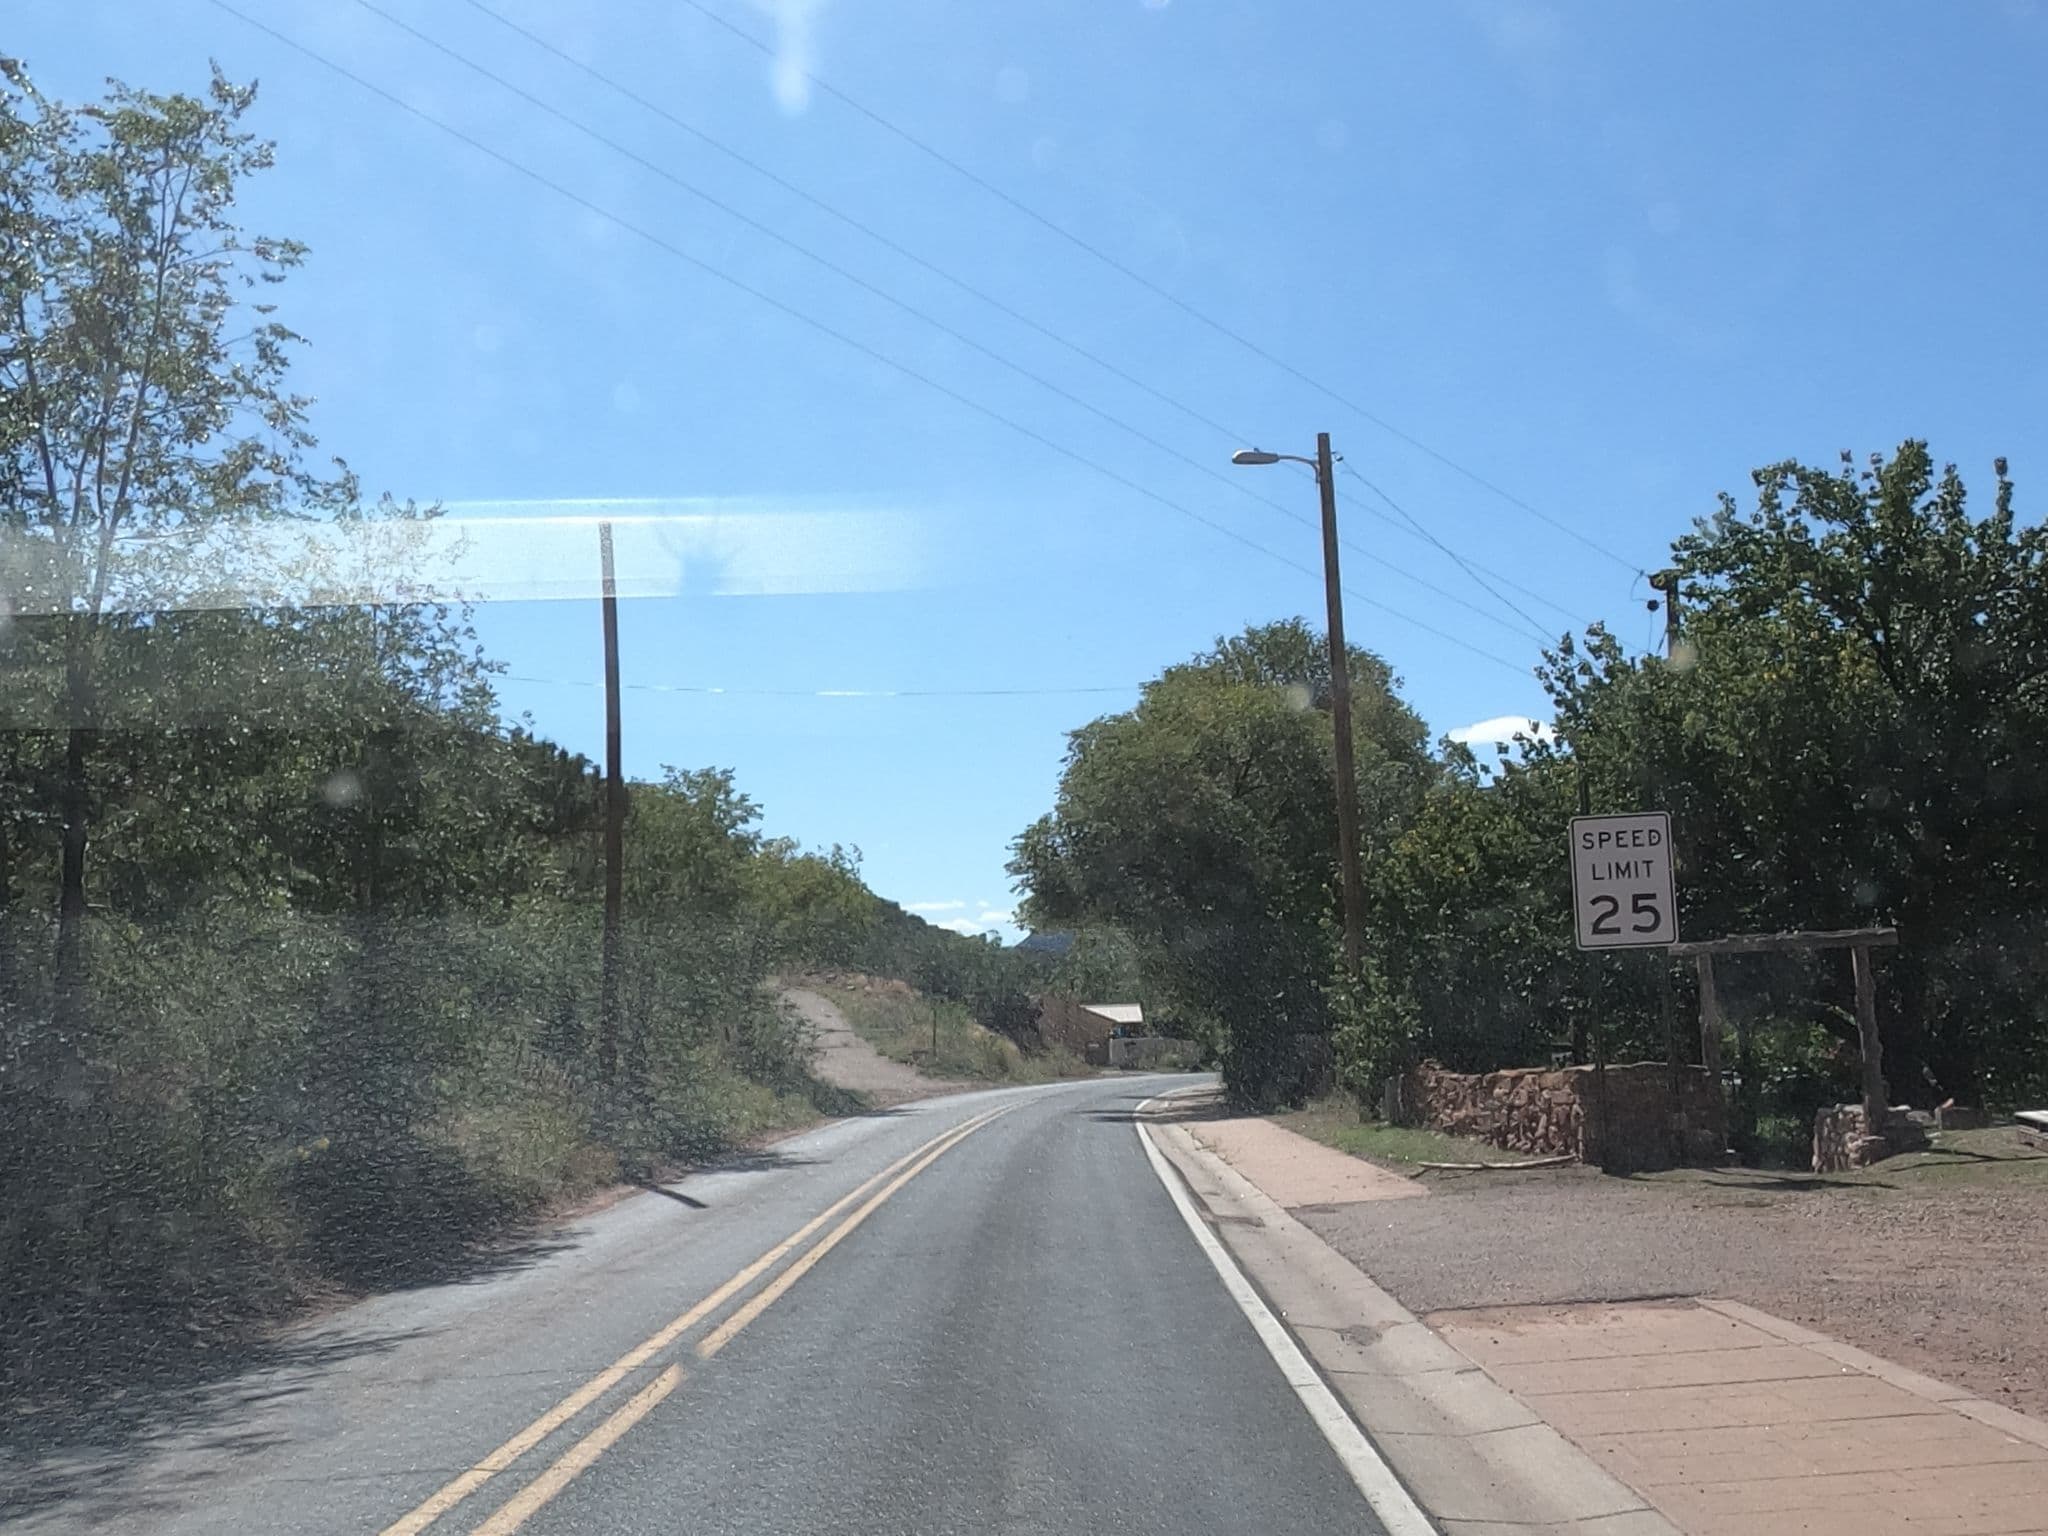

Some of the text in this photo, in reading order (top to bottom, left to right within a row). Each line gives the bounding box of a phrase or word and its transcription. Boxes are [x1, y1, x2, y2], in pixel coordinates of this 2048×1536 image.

[1582, 829, 1661, 850] SPEED
[1592, 860, 1654, 881] LIMIT
[1590, 893, 1661, 935] 25
